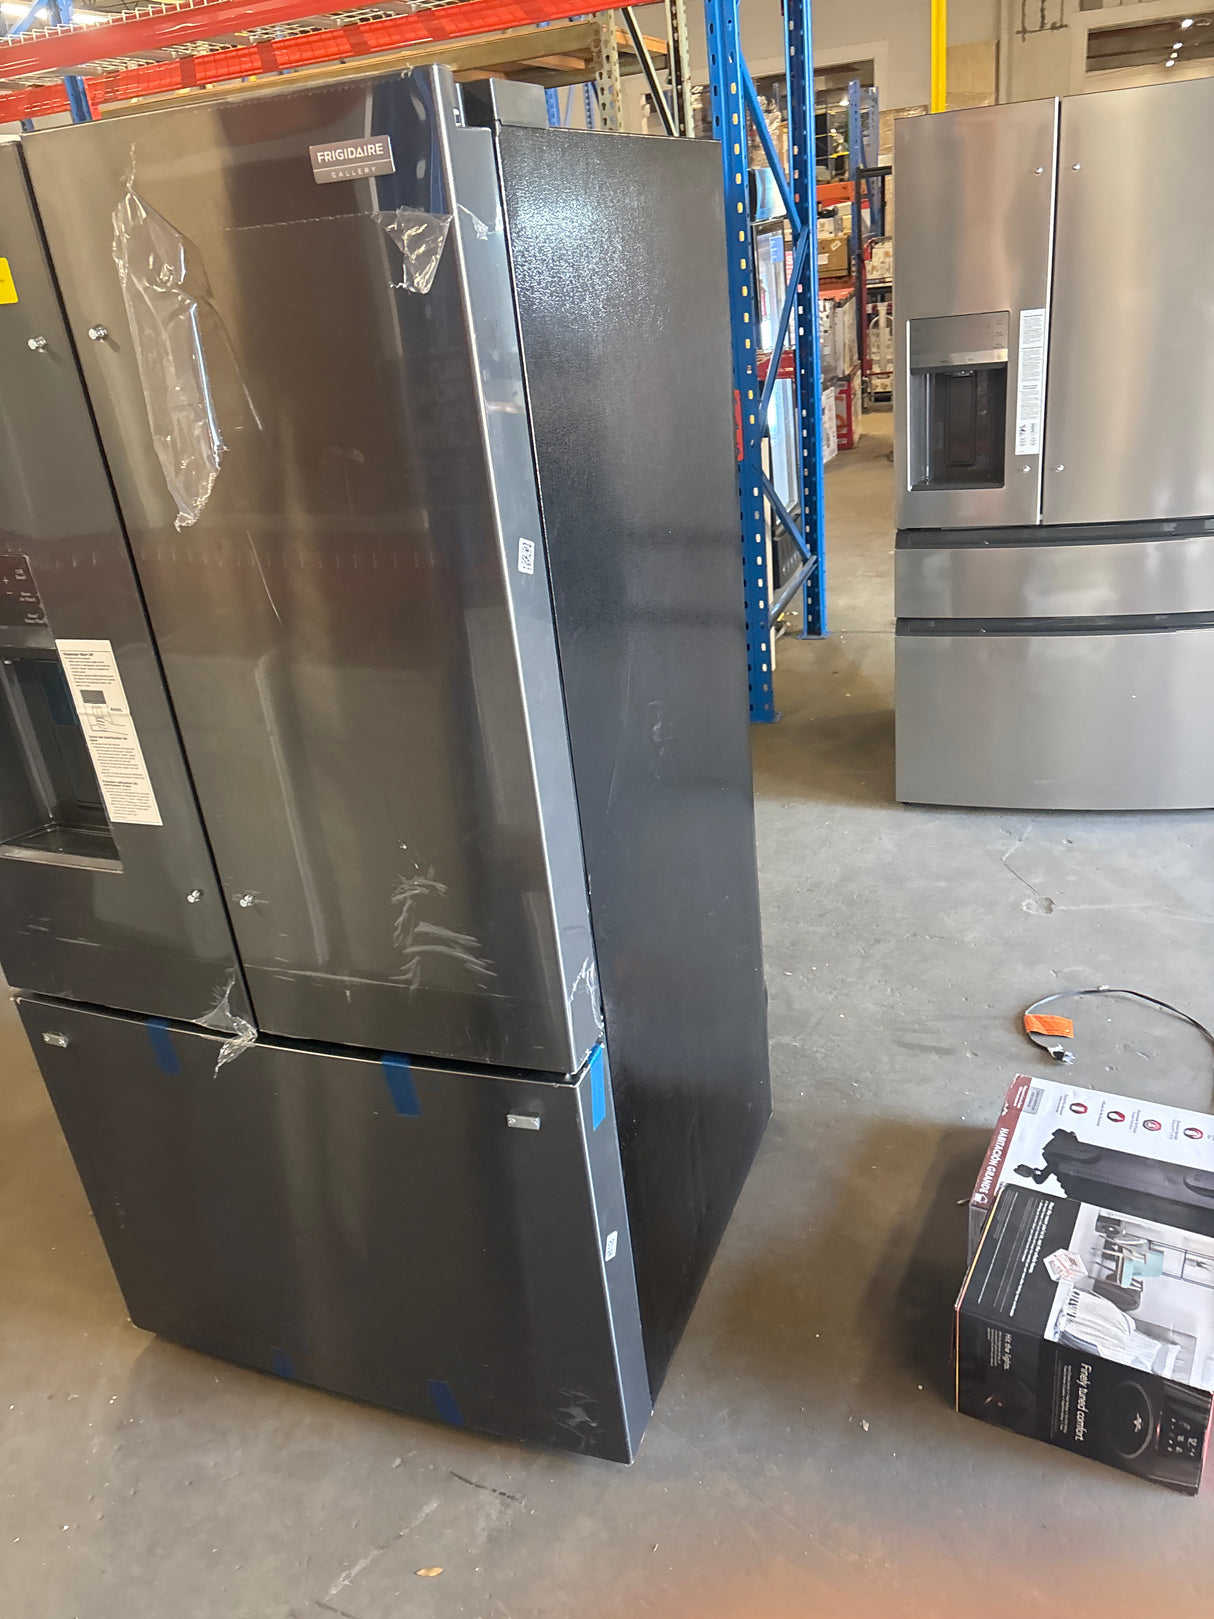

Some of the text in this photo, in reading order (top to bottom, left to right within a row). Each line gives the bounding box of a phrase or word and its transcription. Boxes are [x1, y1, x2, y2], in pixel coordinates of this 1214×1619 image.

[316, 143, 384, 164] FRIGIDAIRE
[330, 166, 377, 178] GALLERY
[979, 1127, 1010, 1194] HABITACIÓN GRANDE
[1076, 1362, 1092, 1388] Finely
[1077, 1387, 1089, 1413] tuned
